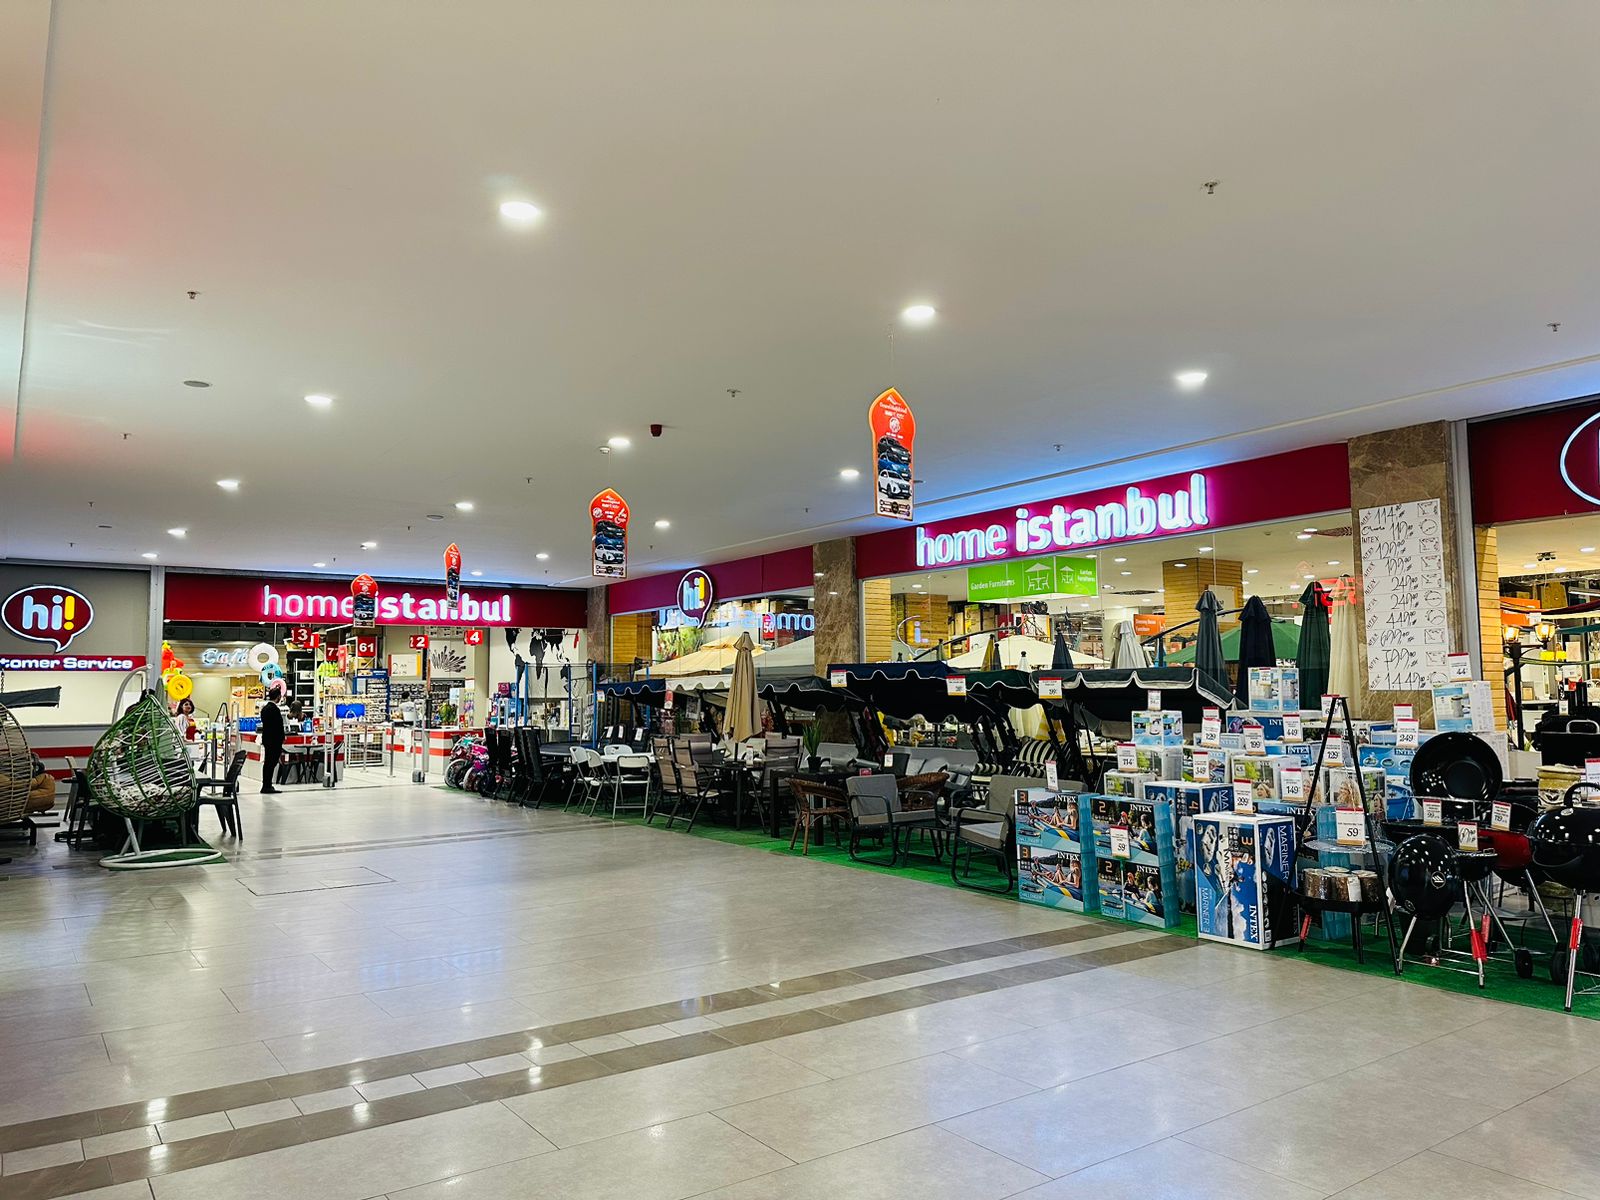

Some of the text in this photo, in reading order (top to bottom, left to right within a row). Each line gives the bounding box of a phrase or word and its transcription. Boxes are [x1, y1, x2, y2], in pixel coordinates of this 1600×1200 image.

[916, 473, 1209, 567] home istanbul
[970, 582, 989, 591] Garden
[683, 576, 705, 611] hi!
[263, 584, 354, 618] home
[22, 595, 75, 631] hi!
[297, 628, 309, 641] 3
[469, 631, 480, 643] 4
[416, 636, 426, 647] 2
[358, 642, 374, 653] 61
[63, 657, 133, 669] Service
[1399, 734, 1414, 742] 249
[1286, 786, 1299, 794] 149
[1020, 792, 1027, 803] 3
[1055, 794, 1076, 803] INTEX
[1099, 801, 1106, 813] 2
[1129, 804, 1152, 813] INTEX
[1188, 800, 1199, 809] 4
[1346, 827, 1359, 837] 59
[1241, 836, 1253, 846] 3
[1117, 843, 1127, 851] 59
[1279, 824, 1290, 880] MARINER
[1022, 847, 1029, 859] 3
[1057, 852, 1080, 861] INTEX
[1105, 861, 1112, 873] 2
[1136, 864, 1159, 875] INTEX
[1201, 888, 1211, 923] MARINER
[1248, 904, 1259, 940] INTEX
